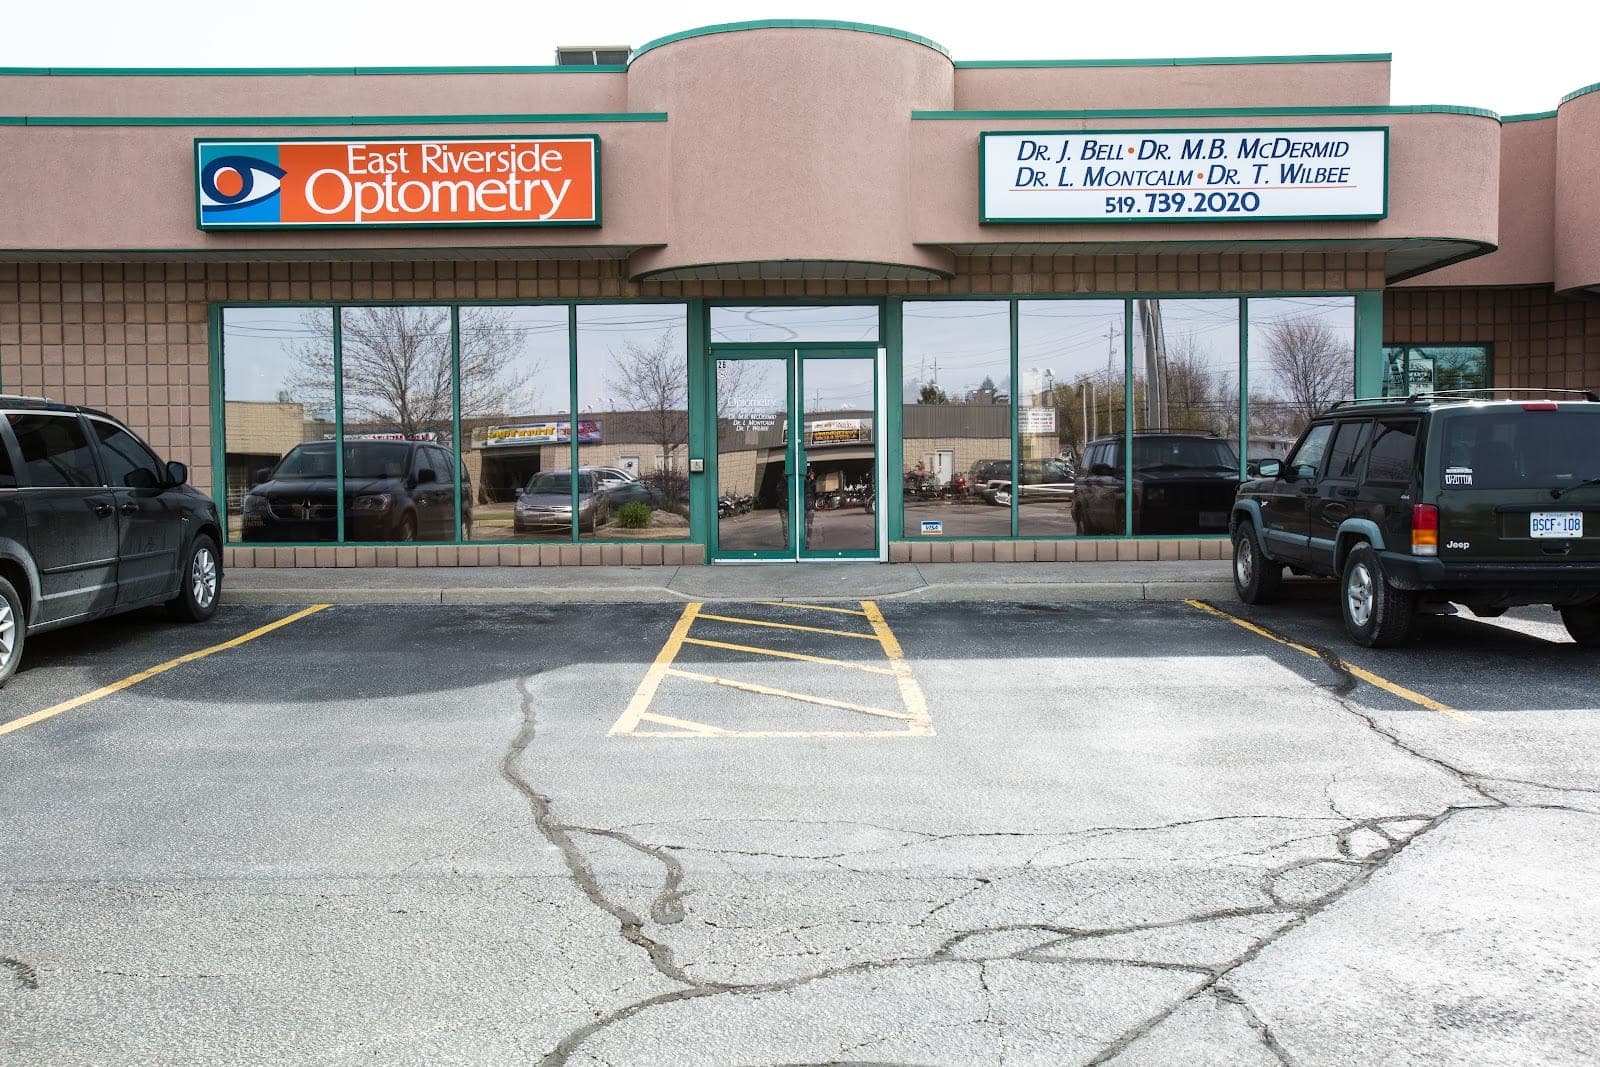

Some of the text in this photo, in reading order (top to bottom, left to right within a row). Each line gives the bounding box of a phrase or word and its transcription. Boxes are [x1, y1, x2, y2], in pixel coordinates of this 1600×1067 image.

[347, 143, 563, 174] East Riverside
[1017, 140, 1051, 161] DR.
[1056, 140, 1071, 164] J.
[1080, 139, 1125, 161] BELL
[1138, 139, 1171, 161] DR.
[1180, 138, 1228, 160] M.B.
[1015, 163, 1351, 187] DR. L. MONTCALM DR. T. WILBEE
[304, 168, 572, 223] Optometry
[1446, 540, 1470, 550] Jeep
